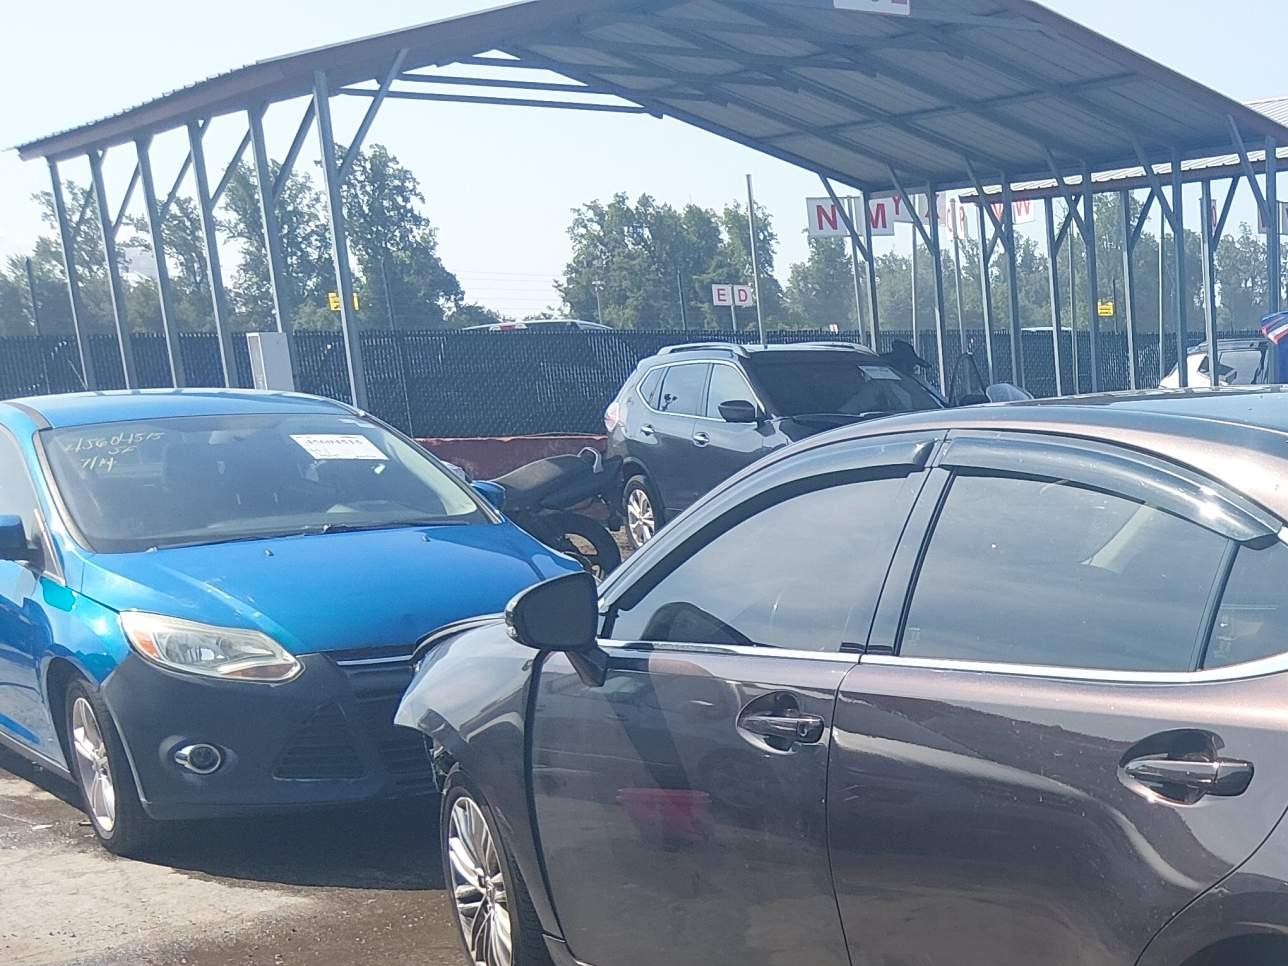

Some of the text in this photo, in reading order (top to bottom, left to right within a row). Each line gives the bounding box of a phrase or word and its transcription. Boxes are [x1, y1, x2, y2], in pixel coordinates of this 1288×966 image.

[815, 204, 839, 231] N
[716, 288, 728, 303] E
[737, 288, 749, 303] D
